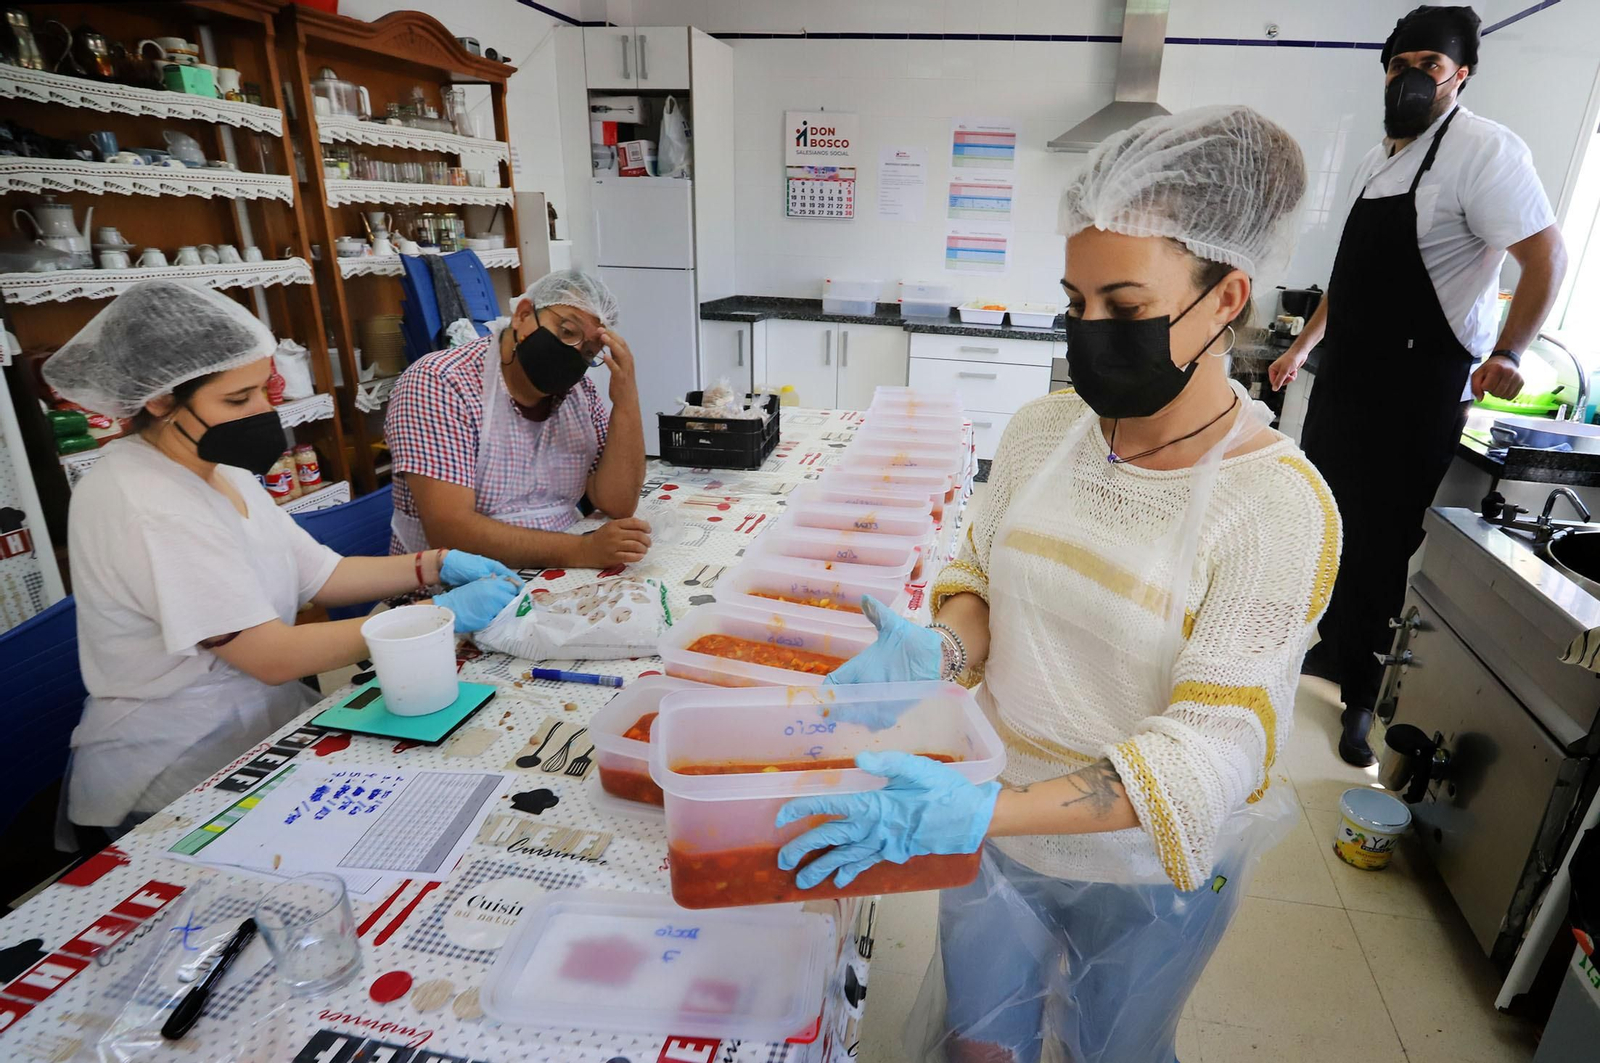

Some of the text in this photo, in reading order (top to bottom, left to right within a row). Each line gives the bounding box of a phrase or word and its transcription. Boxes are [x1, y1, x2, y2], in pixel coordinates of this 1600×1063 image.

[810, 127, 835, 136] DON
[810, 138, 850, 148] BOSCO
[488, 816, 599, 854] HEF
